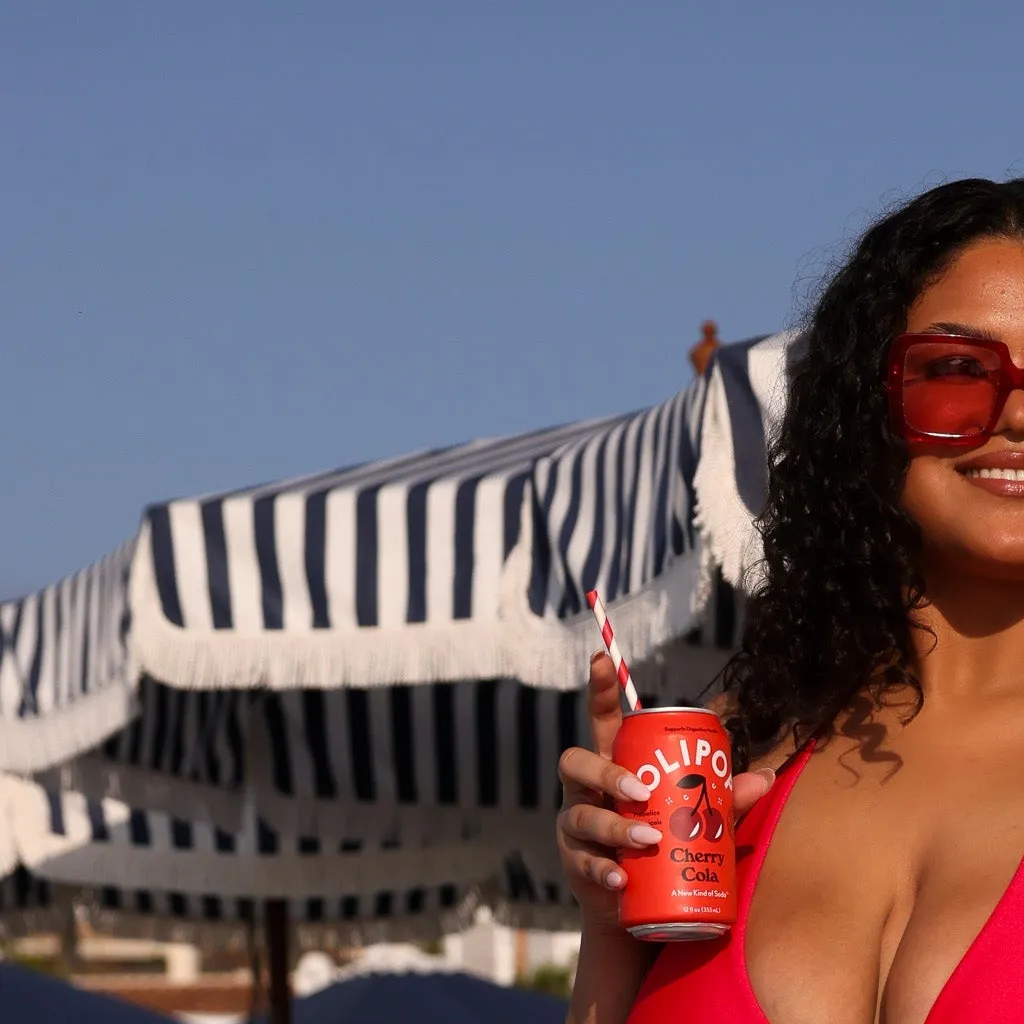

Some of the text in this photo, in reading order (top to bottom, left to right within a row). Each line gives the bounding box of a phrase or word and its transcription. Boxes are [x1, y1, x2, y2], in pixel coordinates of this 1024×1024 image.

[670, 848, 724, 867] Cherry
[681, 867, 719, 883] Cola
[671, 889, 677, 897] A
[677, 889, 693, 897] New
[693, 889, 708, 897] Kind
